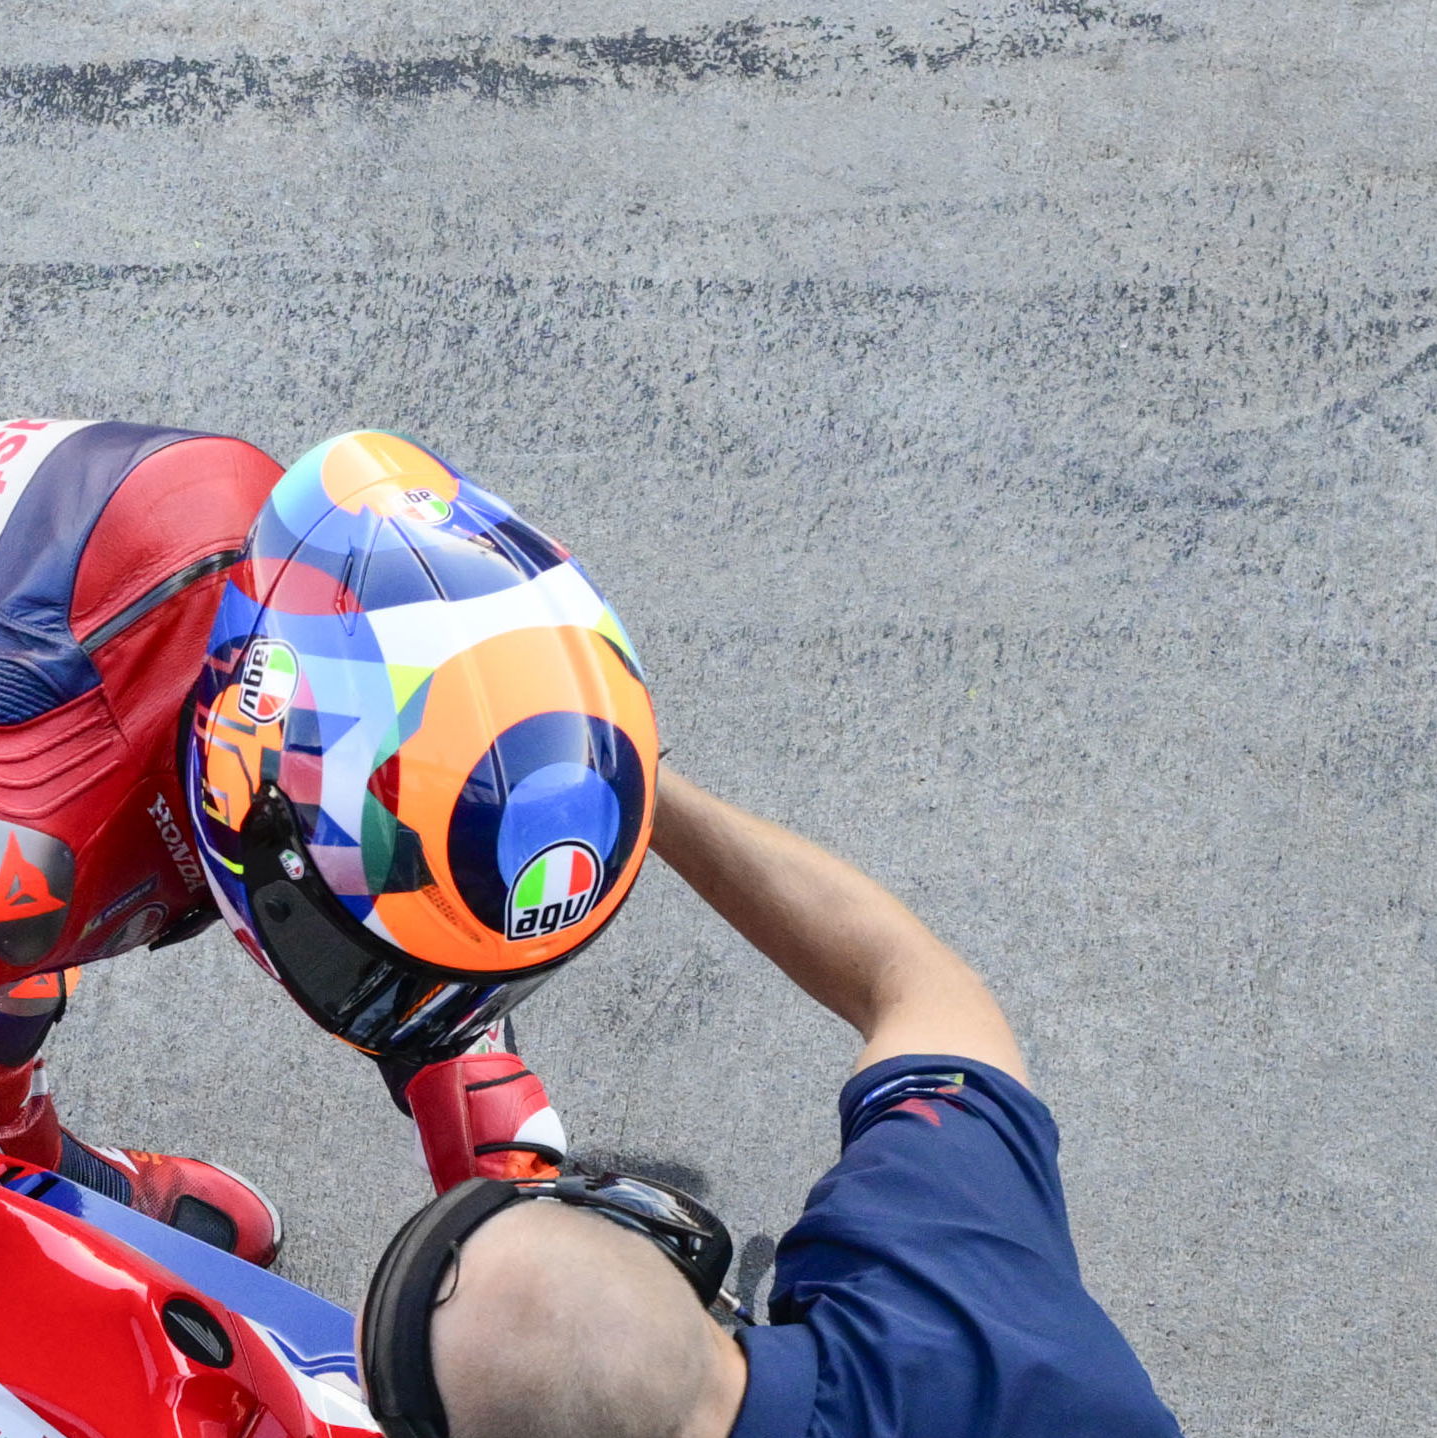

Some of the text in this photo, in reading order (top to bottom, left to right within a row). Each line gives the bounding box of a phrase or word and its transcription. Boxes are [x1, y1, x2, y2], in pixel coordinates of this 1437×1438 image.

[242, 648, 269, 711] agv
[147, 792, 205, 893] HONDA
[515, 893, 587, 934] agv
